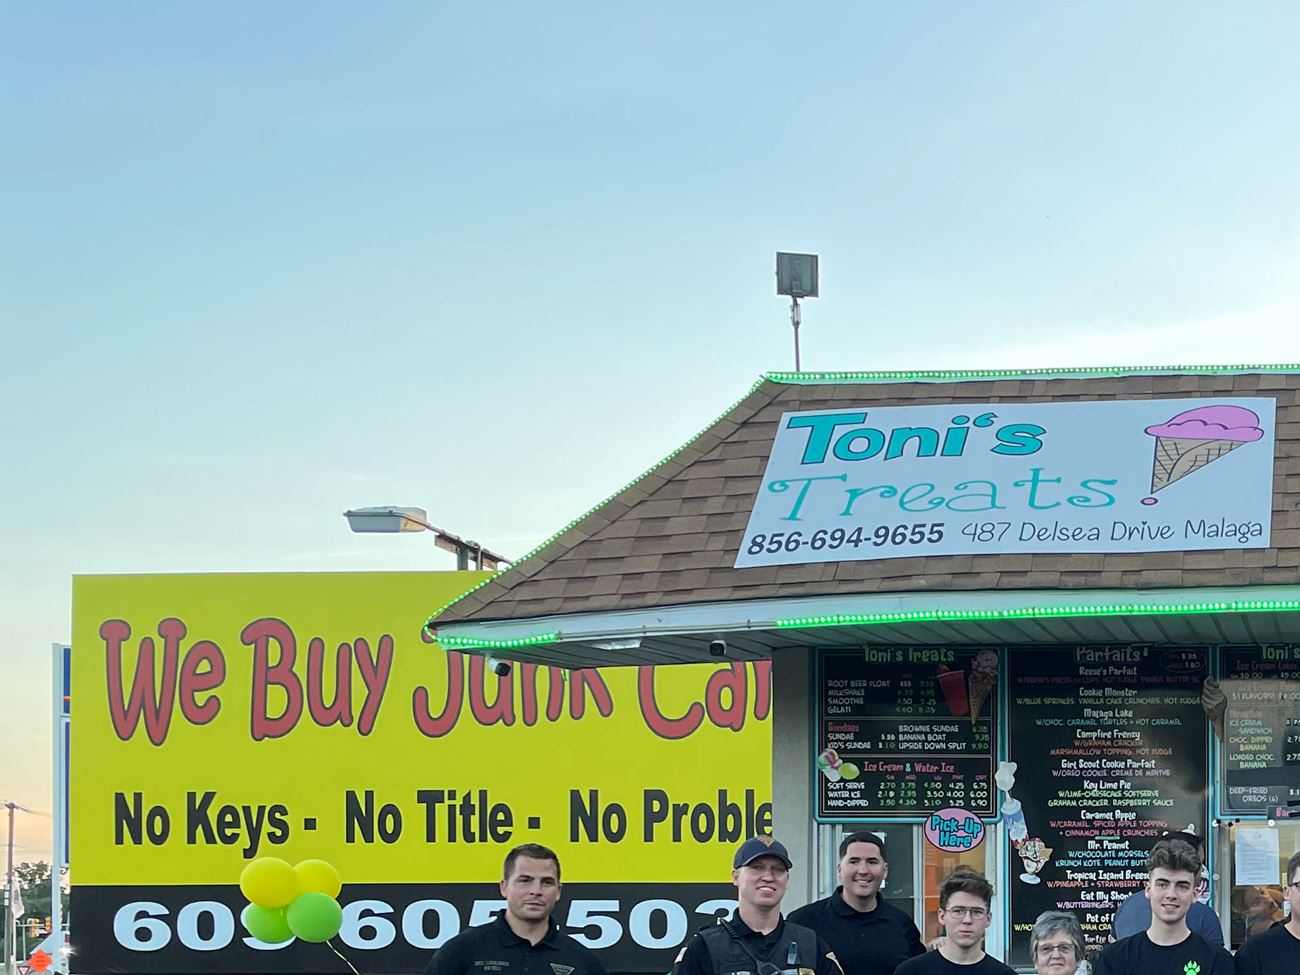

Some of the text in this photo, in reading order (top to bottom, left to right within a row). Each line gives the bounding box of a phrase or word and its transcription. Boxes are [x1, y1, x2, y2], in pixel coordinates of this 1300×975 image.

[785, 411, 1047, 466] Toni's
[768, 466, 1118, 522] Treats
[747, 516, 1263, 557] 856-694-9655 487 Delsea Drive Malaga
[864, 646, 954, 662] Toni's Treats
[1076, 646, 1141, 662] Parfaits
[1260, 643, 1300, 659] Toni's
[1109, 667, 1137, 675] Parfait
[99, 617, 226, 747] We
[240, 617, 394, 742] Buy
[1079, 688, 1137, 697] Cookie Monster
[1115, 709, 1133, 717] Lake
[899, 725, 931, 733] BROWNIE
[1077, 730, 1140, 740] Campfire Frenzy
[925, 742, 946, 750] DOWN
[948, 742, 966, 750] SPLIT
[864, 762, 954, 773] Ice Cream & Water Ice
[1079, 760, 1100, 768] Scout
[1102, 760, 1125, 769] Cookie
[1127, 760, 1155, 768] Parfait
[1084, 780, 1131, 791] Key Lime Pie
[1081, 810, 1137, 821] Caramel Apple
[114, 792, 170, 846] No
[186, 791, 290, 859] Keys
[345, 789, 402, 844] No
[417, 789, 513, 844] Title
[569, 789, 627, 844] No
[931, 815, 982, 838] Pick-Up
[939, 831, 972, 848] Here
[1087, 841, 1130, 849] Mr. Peanut
[1066, 870, 1124, 881] Tropical Island
[1081, 891, 1109, 902] Eat My
[1086, 914, 1111, 922] Pot of
